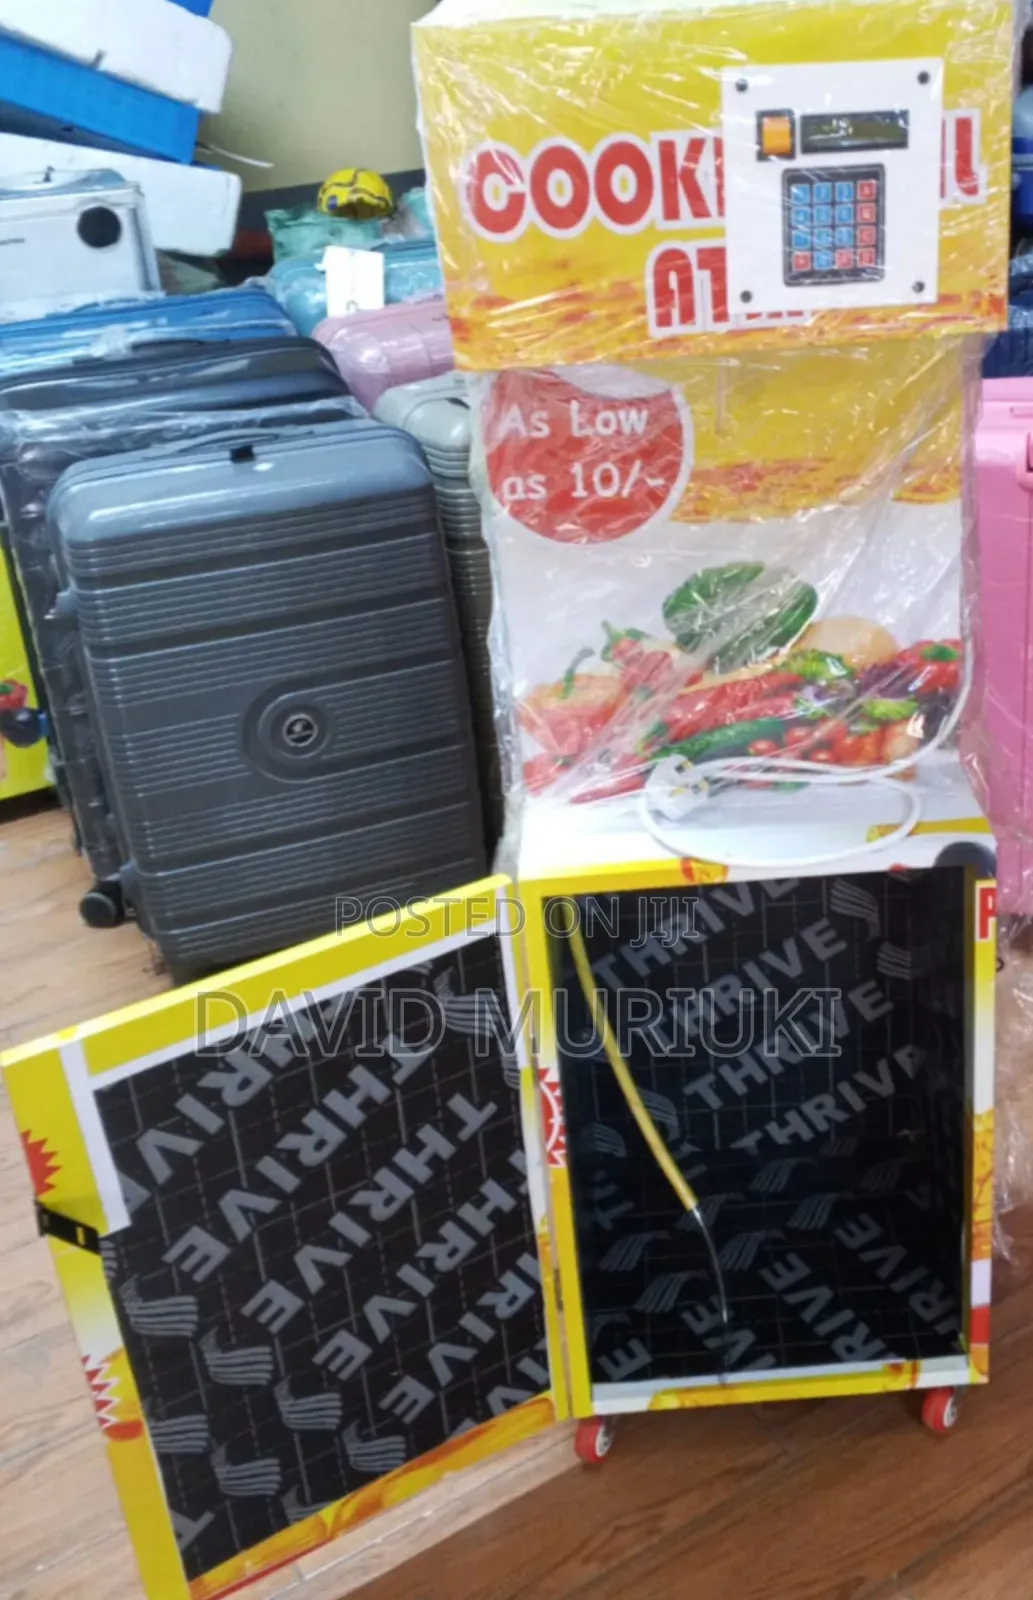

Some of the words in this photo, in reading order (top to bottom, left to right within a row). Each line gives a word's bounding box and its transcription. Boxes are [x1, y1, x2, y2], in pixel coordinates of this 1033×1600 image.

[652, 247, 804, 329] AT
[498, 404, 550, 438] As
[571, 399, 649, 437] Low
[503, 474, 548, 501] as
[570, 459, 665, 499] 10/-
[636, 917, 849, 1051] THRIVE
[683, 979, 894, 1110] THRIVE
[162, 1033, 433, 1283] THRIVE
[241, 1093, 498, 1333] THRIVE
